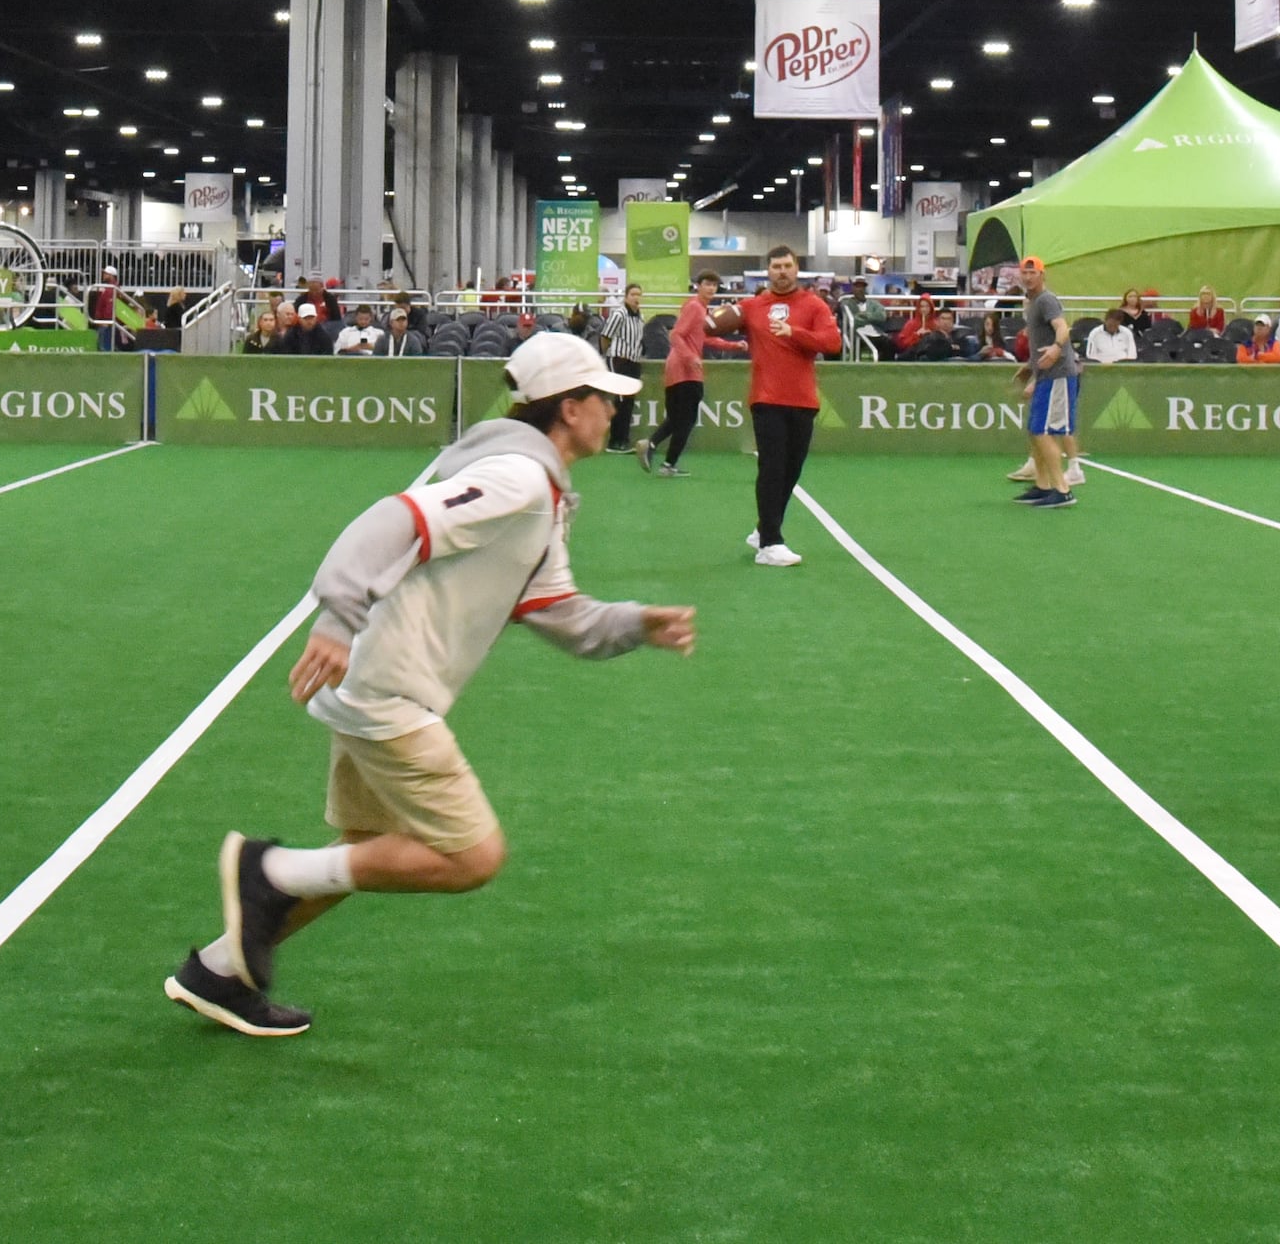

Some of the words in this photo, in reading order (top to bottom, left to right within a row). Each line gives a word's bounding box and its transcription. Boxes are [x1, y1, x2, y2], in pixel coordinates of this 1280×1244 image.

[801, 25, 838, 54] Dr
[764, 33, 862, 82] Pepper
[542, 218, 594, 235] NEXT
[542, 235, 592, 252] STEP
[541, 260, 567, 273] GOT
[248, 387, 437, 425] REGIONS
[859, 395, 1025, 430] REGION
[443, 486, 484, 509] 1
